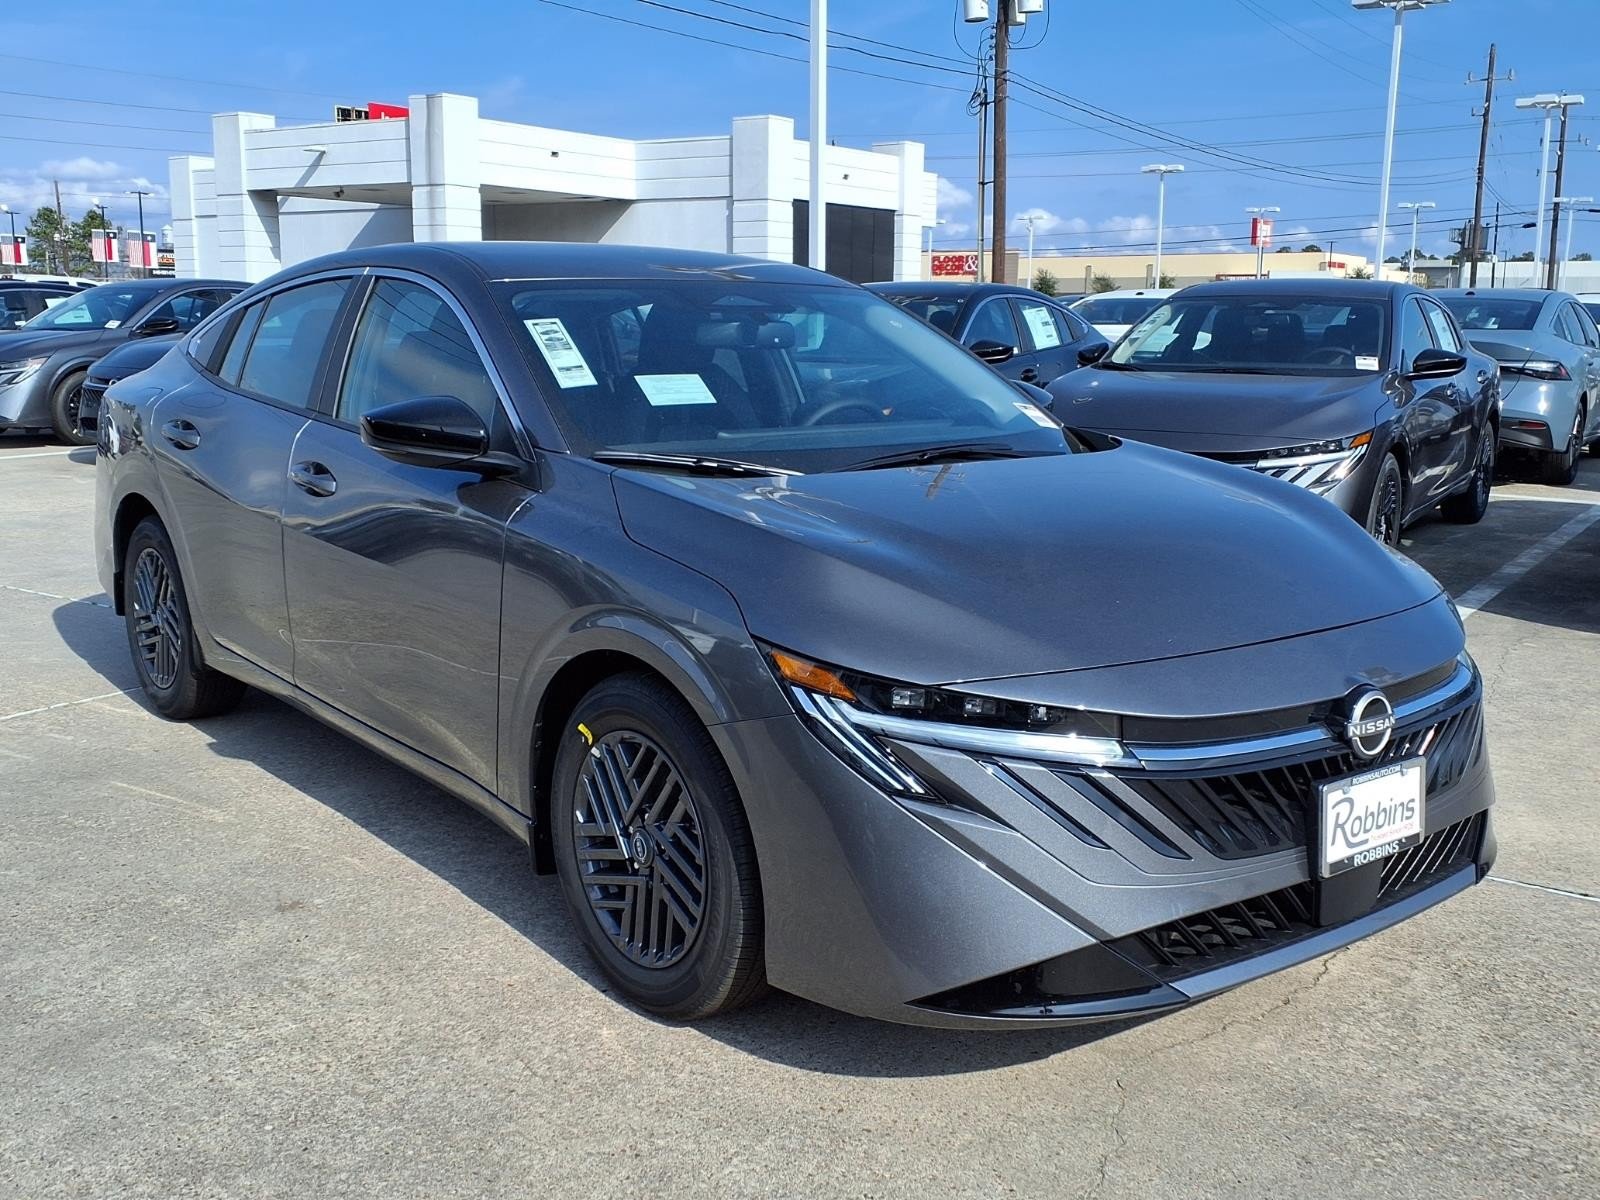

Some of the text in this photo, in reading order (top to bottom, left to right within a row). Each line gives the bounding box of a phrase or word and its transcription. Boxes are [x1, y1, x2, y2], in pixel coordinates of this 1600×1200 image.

[965, 255, 978, 271] &
[1348, 717, 1396, 737] NISSAN
[1331, 797, 1415, 849] Robbins
[1354, 840, 1399, 867] ROBBINS
